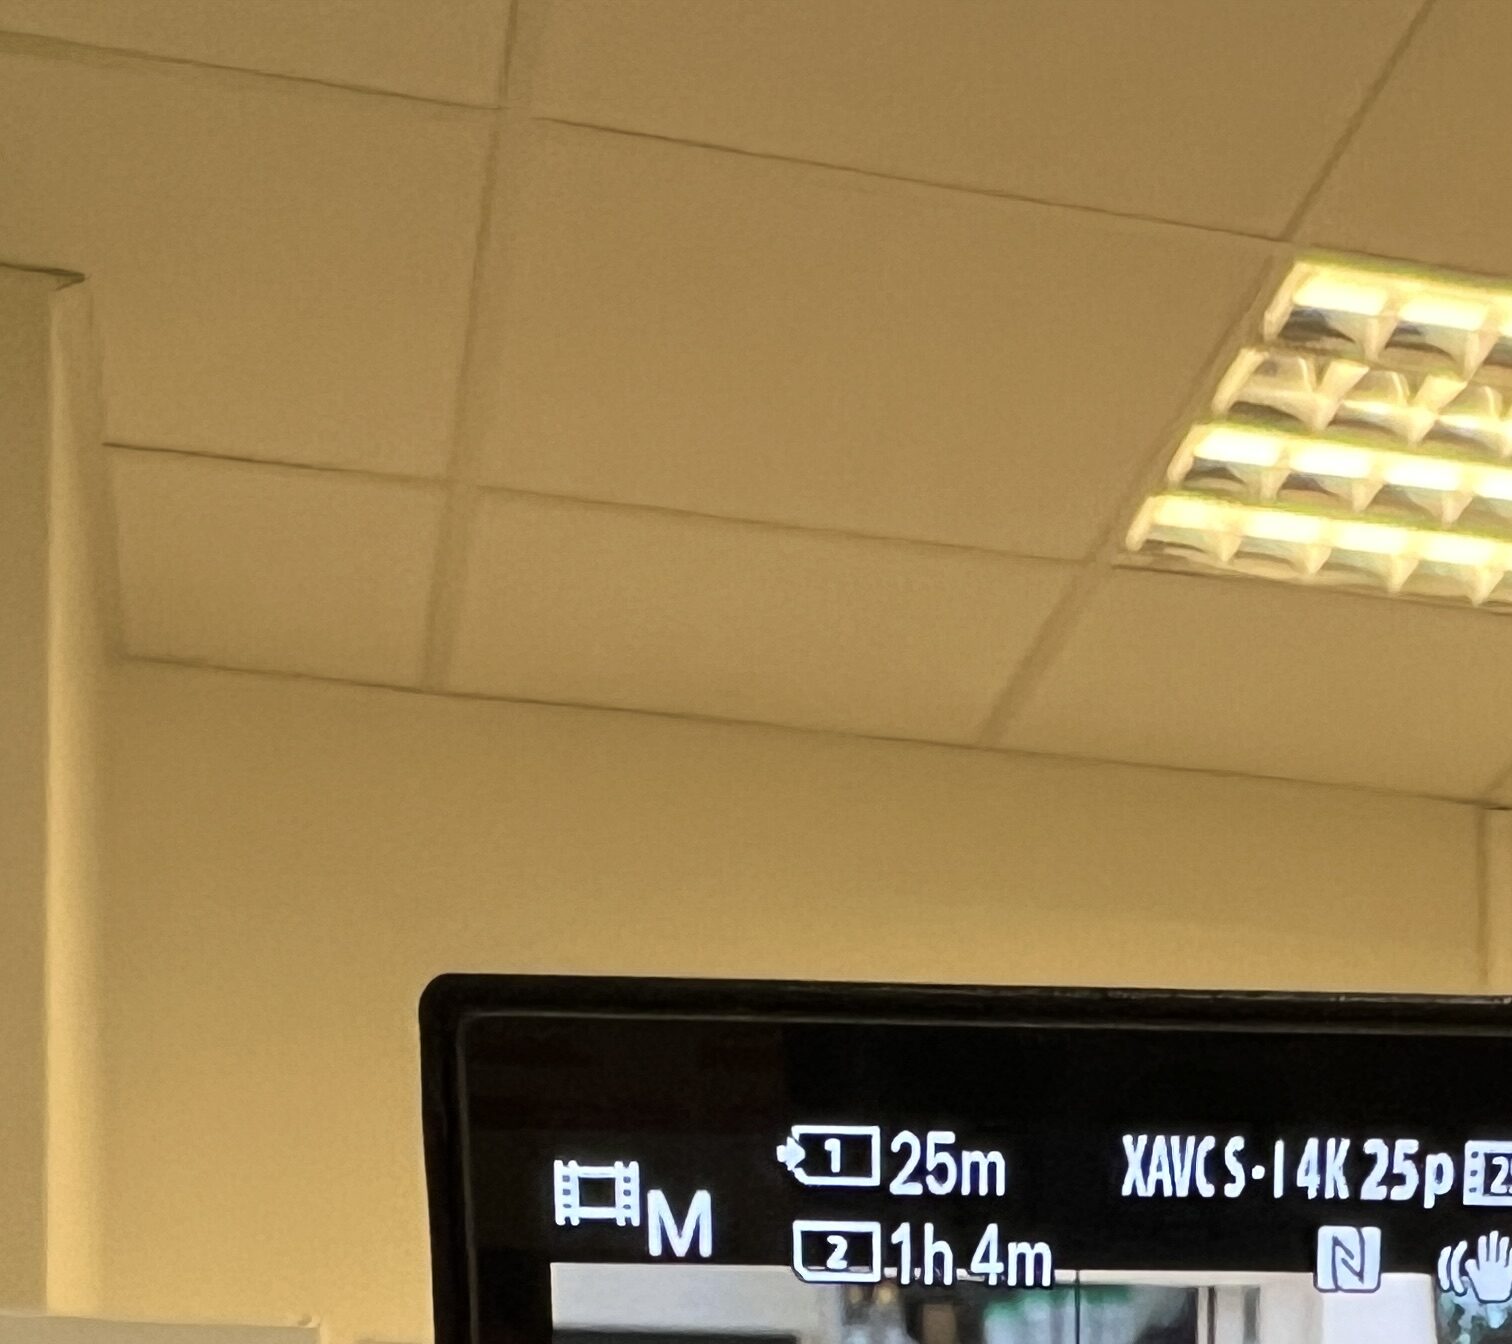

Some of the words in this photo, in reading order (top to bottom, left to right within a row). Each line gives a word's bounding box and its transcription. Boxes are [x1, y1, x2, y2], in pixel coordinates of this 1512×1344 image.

[889, 1130, 1006, 1196] 25m
[1360, 1138, 1455, 1209] 25p
[647, 1189, 713, 1258] M
